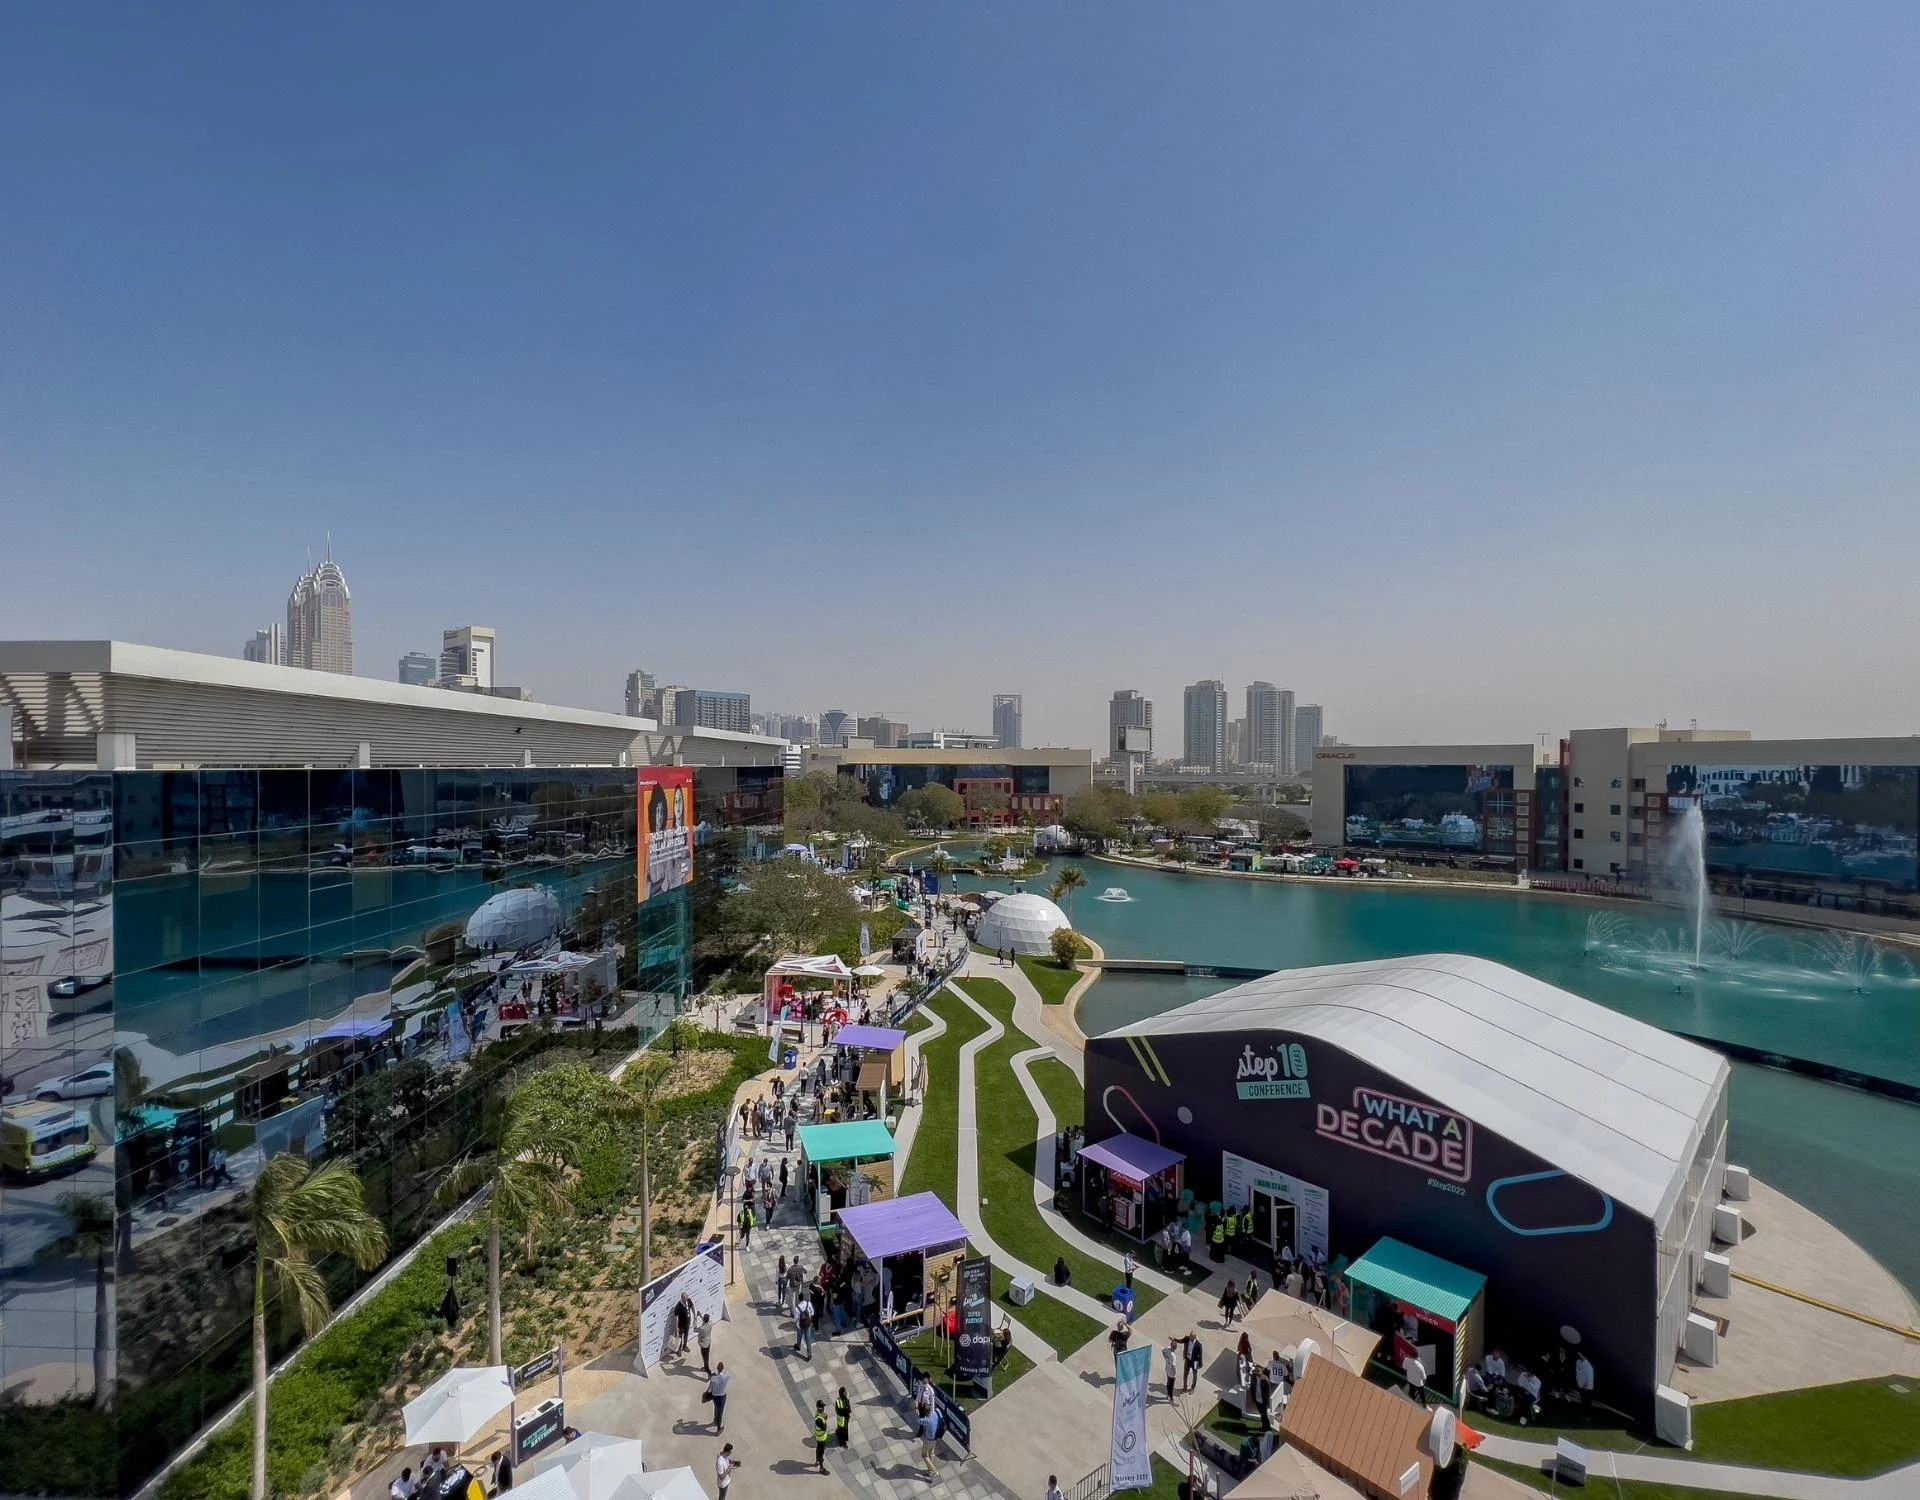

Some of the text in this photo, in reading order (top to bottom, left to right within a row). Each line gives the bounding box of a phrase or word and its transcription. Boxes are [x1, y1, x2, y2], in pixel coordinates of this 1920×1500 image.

[1292, 1048, 1304, 1072] YEARS
[1248, 1083, 1304, 1097] CONFERENCE
[1362, 1093, 1463, 1141] WHAT A
[1316, 1103, 1465, 1171] DECADE
[1427, 1177, 1467, 1197] #Step2022
